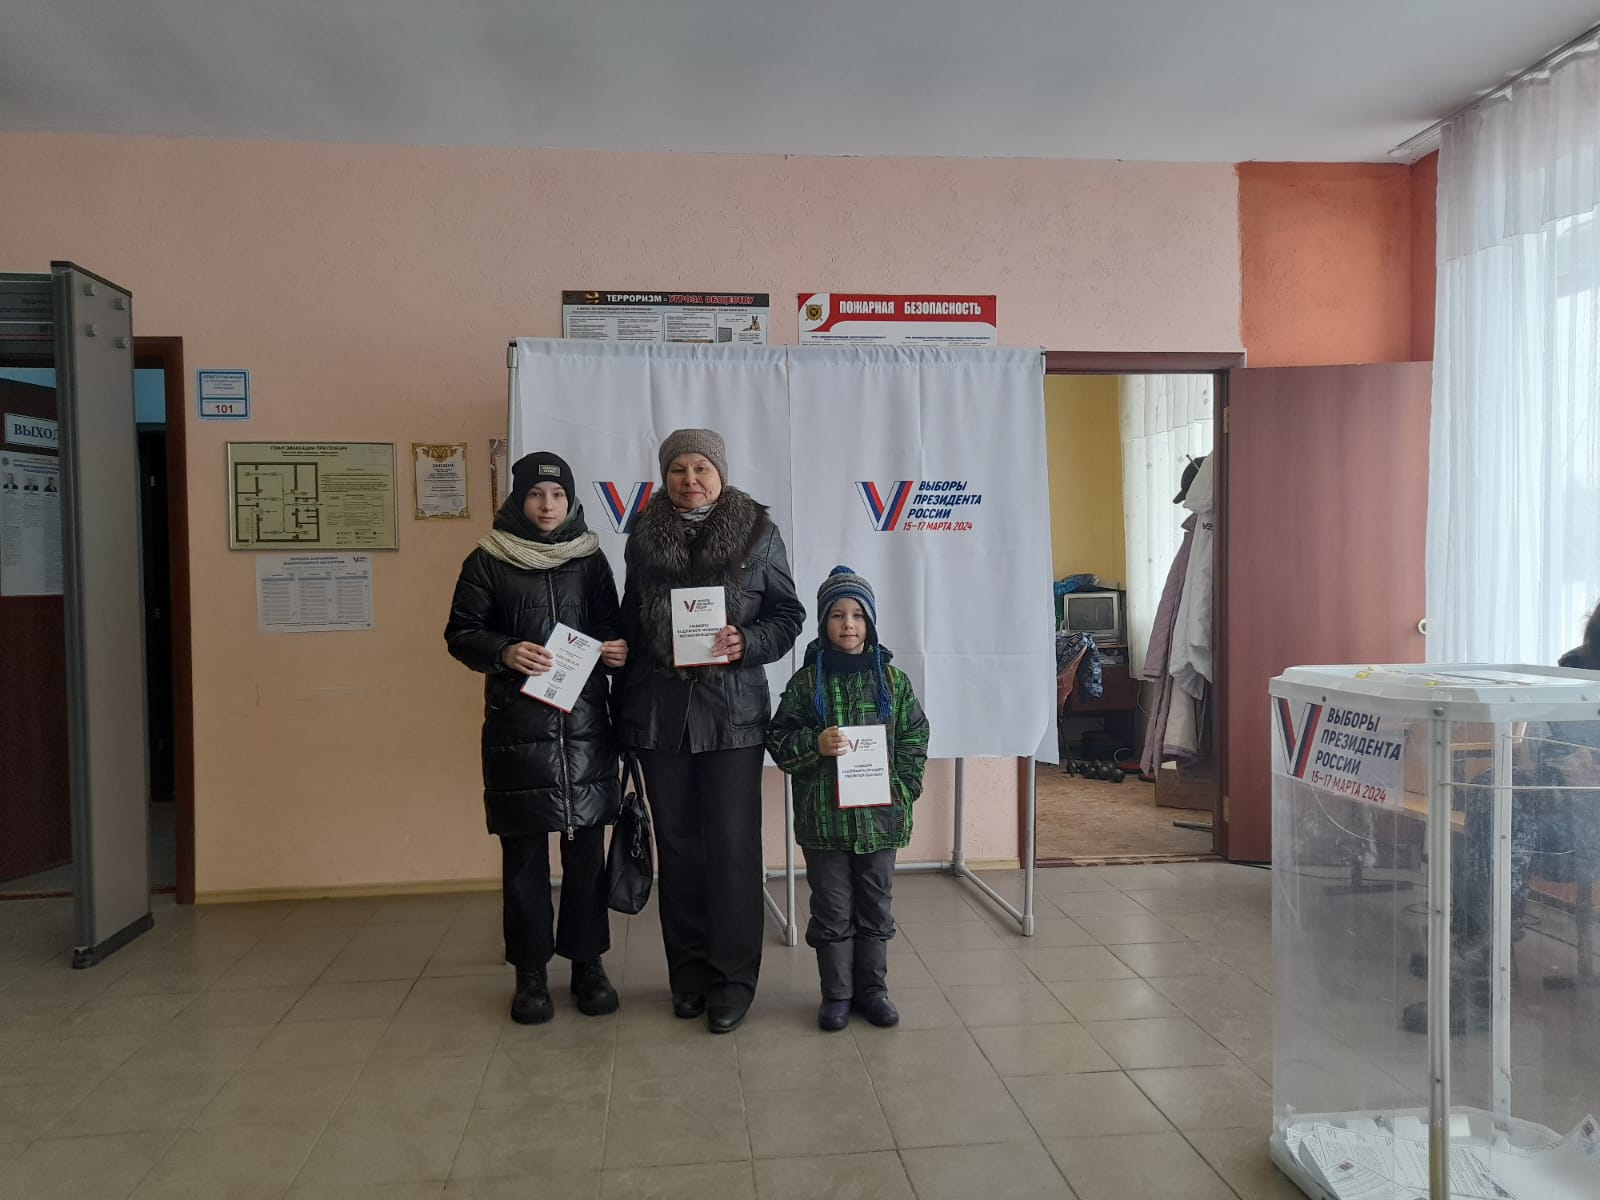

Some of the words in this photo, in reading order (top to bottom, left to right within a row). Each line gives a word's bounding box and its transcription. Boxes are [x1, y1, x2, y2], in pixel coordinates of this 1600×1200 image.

[606, 294, 662, 303] ТЕРРОРИЗМ
[668, 294, 704, 304] УГРОЗА
[839, 300, 895, 314] ПОЖАРНАЯ
[904, 300, 982, 315] БЕЗОПАСНОСТЬ
[215, 404, 233, 414] 101
[918, 480, 968, 491] ВЫБОРЫ
[912, 494, 982, 506] ПРЕЗИДЕНТА
[907, 508, 952, 519] РОССИИ
[926, 521, 952, 531] МАРТА
[953, 521, 973, 531] 2024
[1326, 707, 1381, 732] ВЫБОРЫ
[1320, 729, 1402, 761] ПРЕЗИДЕНТА
[1315, 750, 1362, 775] РОССИИ
[1333, 776, 1361, 794] МАРТА
[1362, 785, 1386, 803] 2024
